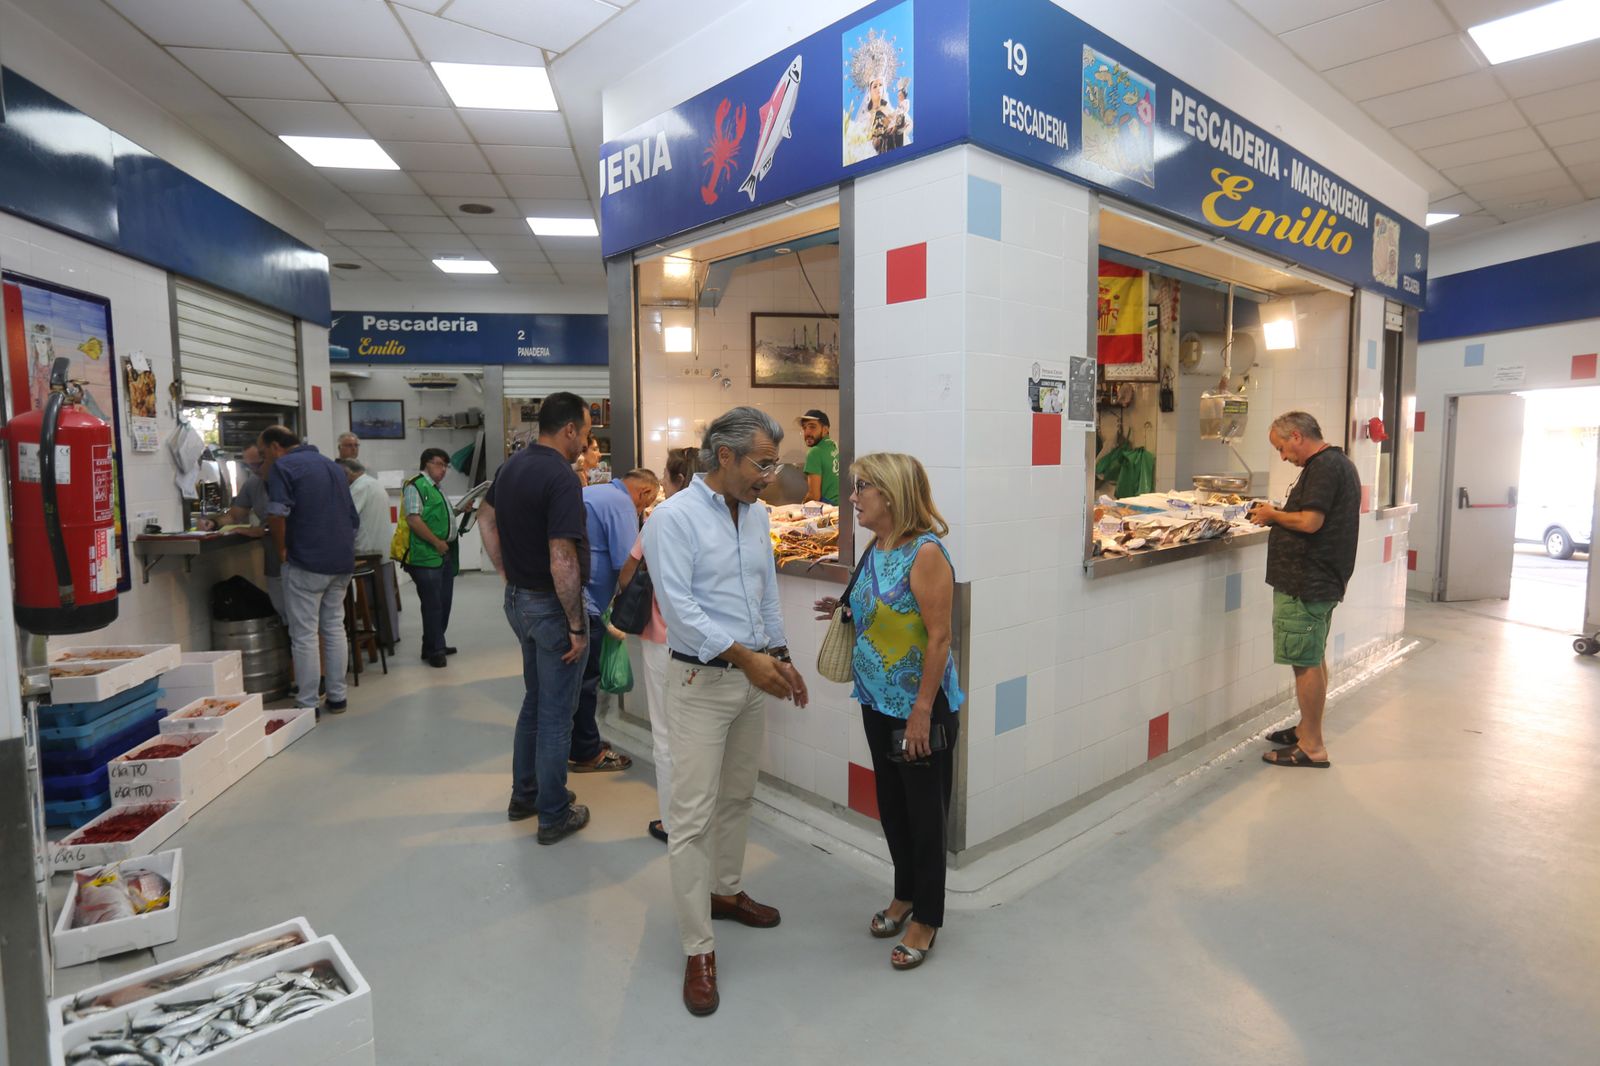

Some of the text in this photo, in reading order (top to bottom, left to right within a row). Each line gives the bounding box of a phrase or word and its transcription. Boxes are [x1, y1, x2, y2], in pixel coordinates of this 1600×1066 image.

[1003, 38, 1028, 76] 19
[1002, 94, 1069, 150] PESCADERIA
[1170, 88, 1280, 181] PESCADERIA
[1290, 157, 1369, 229] MARISQUERIA
[1201, 167, 1353, 255] Emilio
[363, 315, 478, 332] Pescaderia
[517, 330, 526, 341] 2
[358, 337, 406, 356] Emilio
[517, 346, 551, 358] PANADERIA
